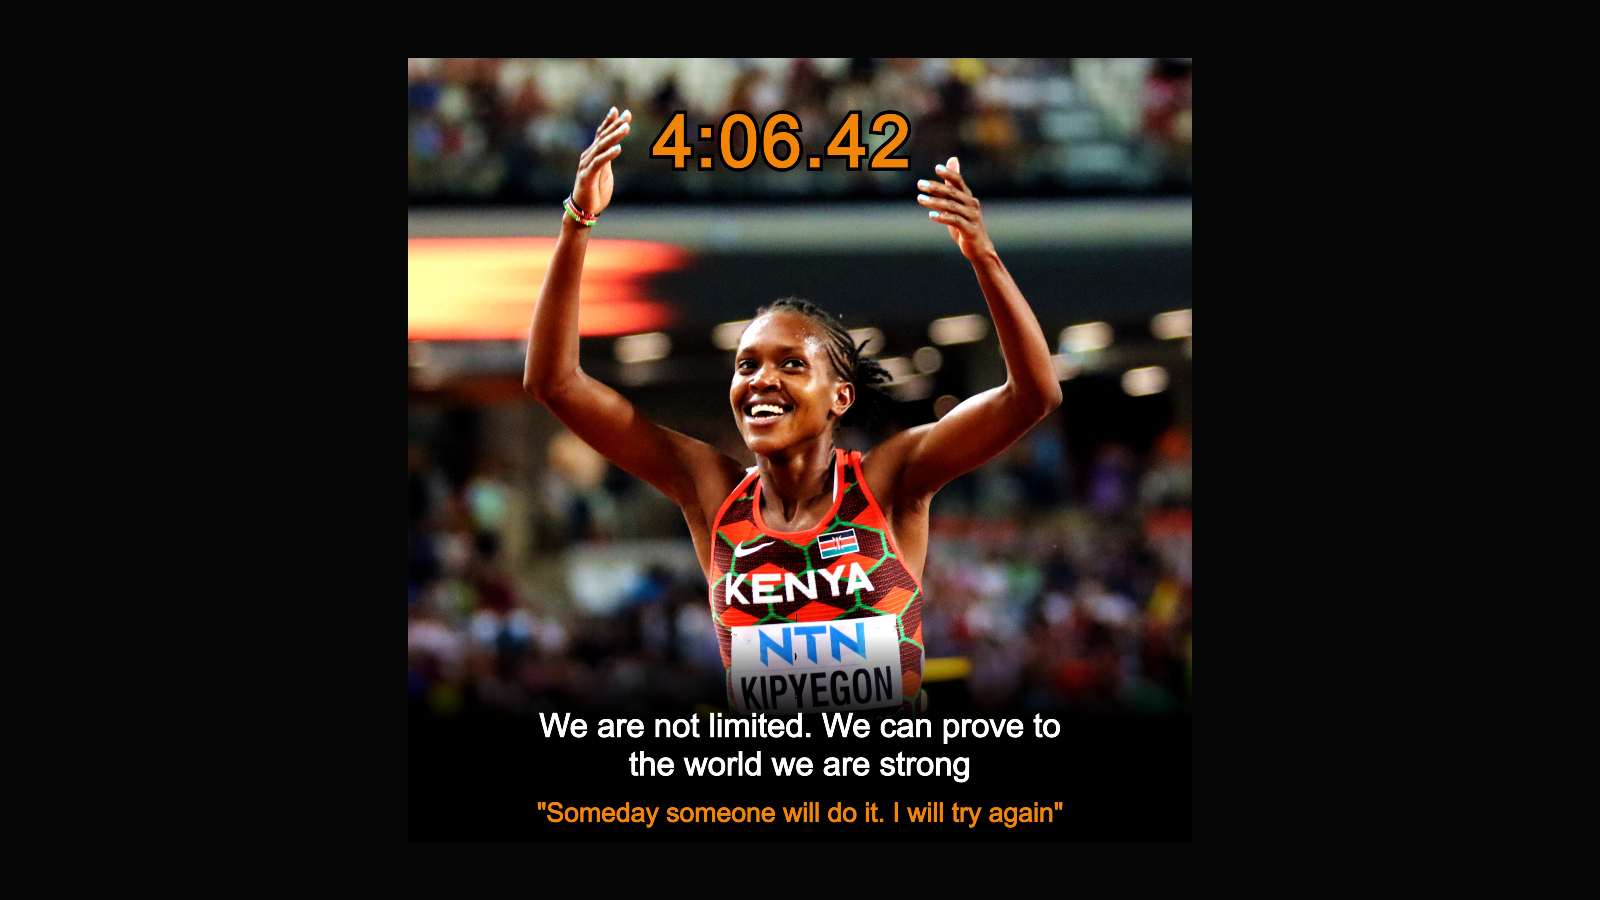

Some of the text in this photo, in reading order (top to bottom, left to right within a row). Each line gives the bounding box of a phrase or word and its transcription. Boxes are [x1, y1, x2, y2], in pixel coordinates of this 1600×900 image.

[725, 562, 875, 605] KENYA
[758, 622, 867, 667] NTN
[740, 665, 894, 711] KIPYEGON
